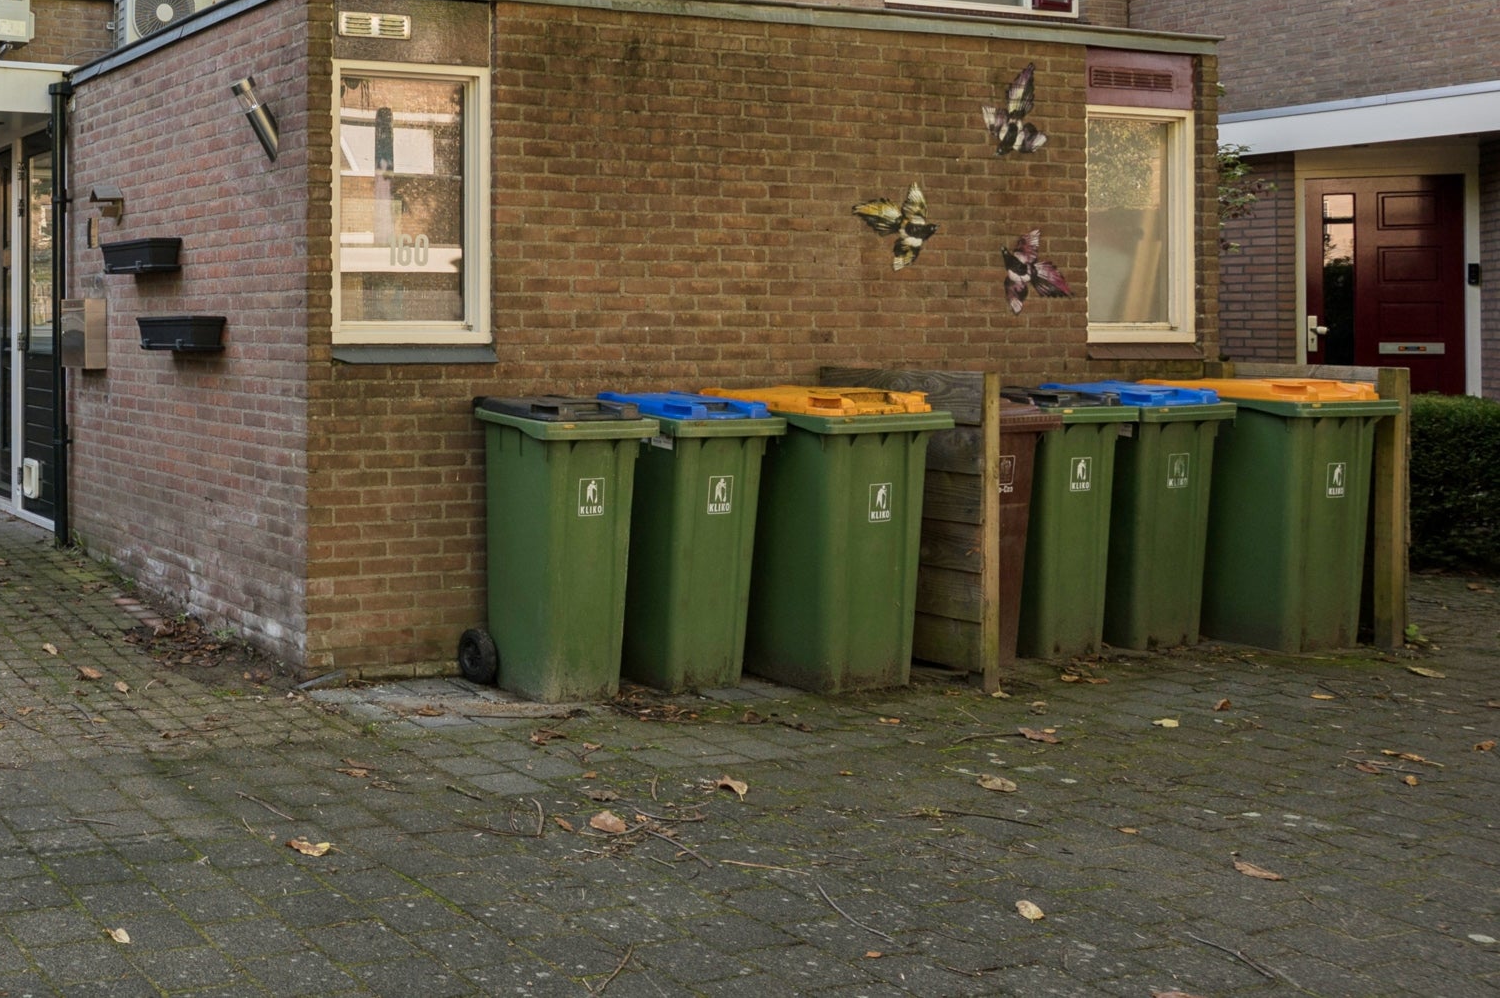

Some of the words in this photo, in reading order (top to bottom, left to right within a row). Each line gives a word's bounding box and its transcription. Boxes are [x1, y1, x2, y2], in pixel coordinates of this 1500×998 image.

[388, 233, 429, 267] 160
[580, 505, 602, 515] KLIKO
[709, 502, 730, 512] KLIKO
[870, 510, 890, 520] KLIKO
